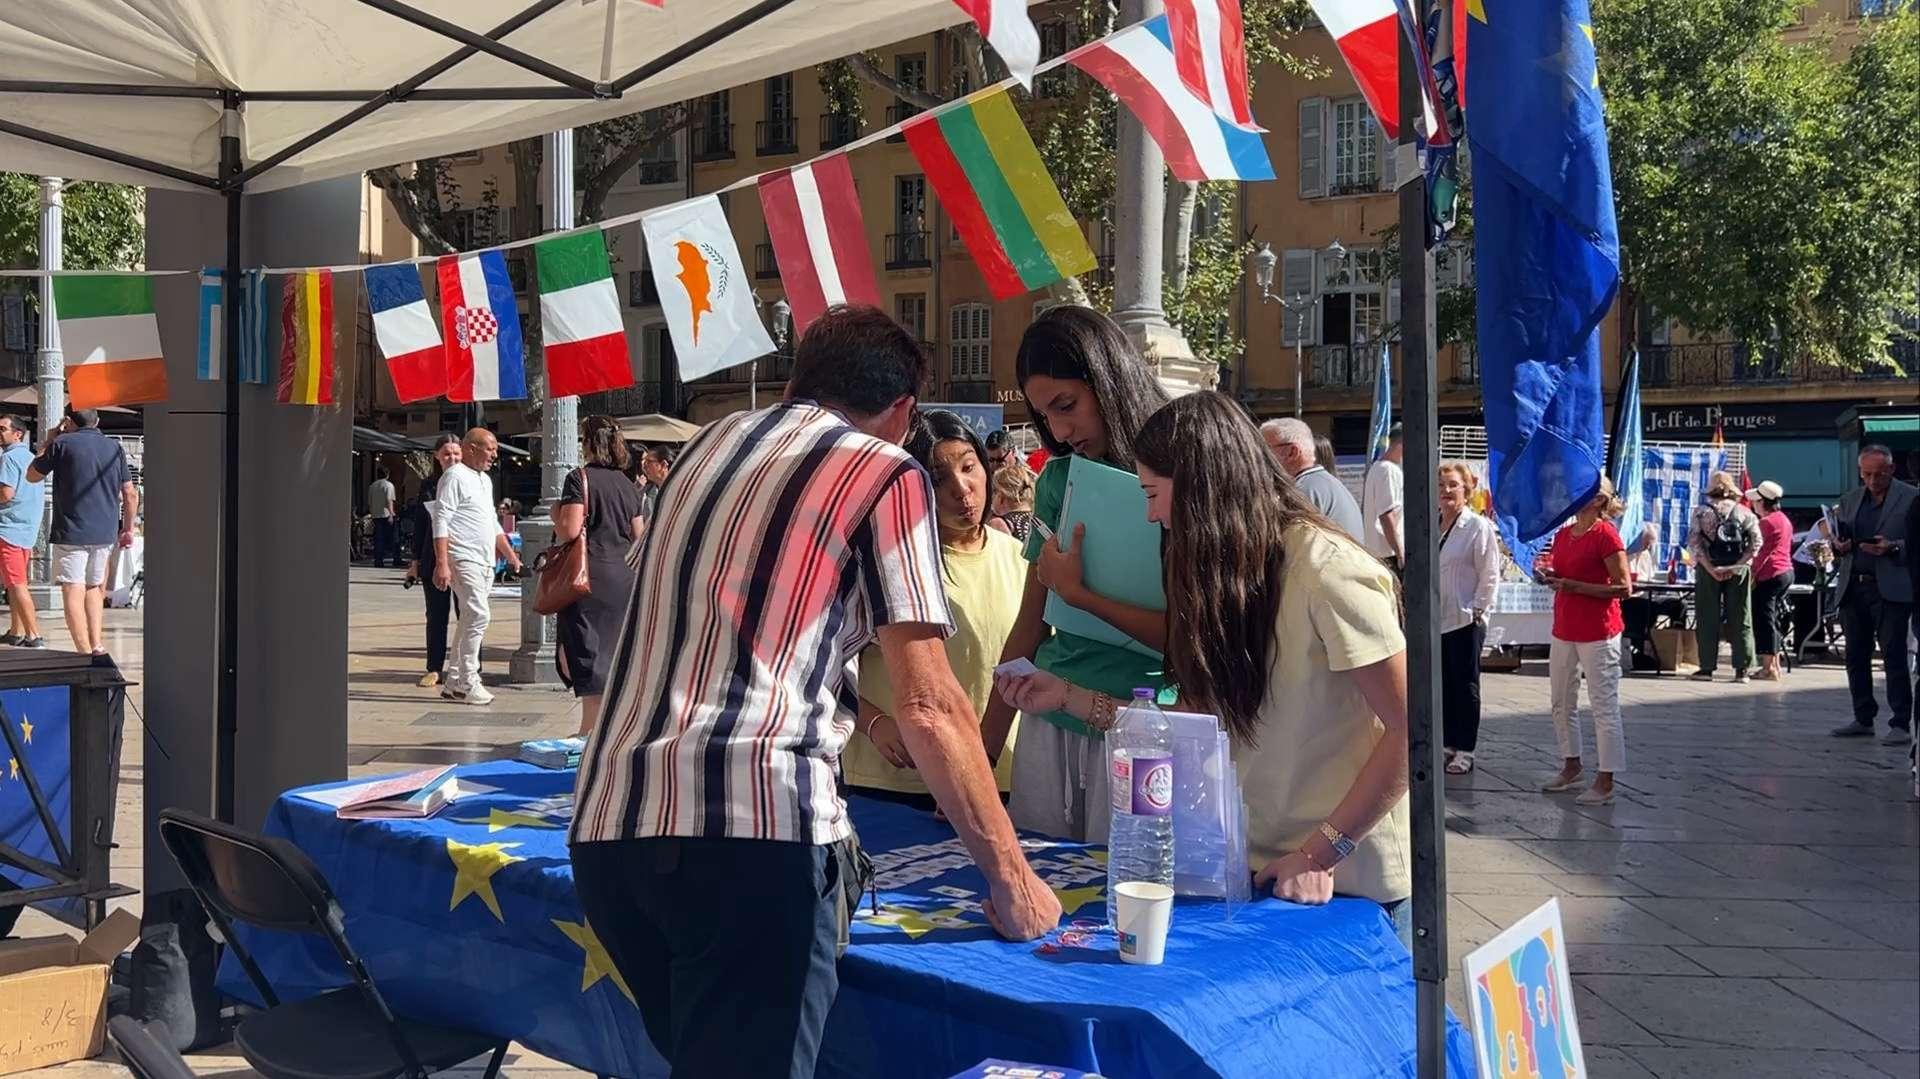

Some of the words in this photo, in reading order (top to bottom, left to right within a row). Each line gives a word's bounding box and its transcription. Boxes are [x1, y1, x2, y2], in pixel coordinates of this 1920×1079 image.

[1646, 411, 1683, 431] Jeff
[1685, 415, 1701, 427] de
[1703, 407, 1776, 428] Bruges
